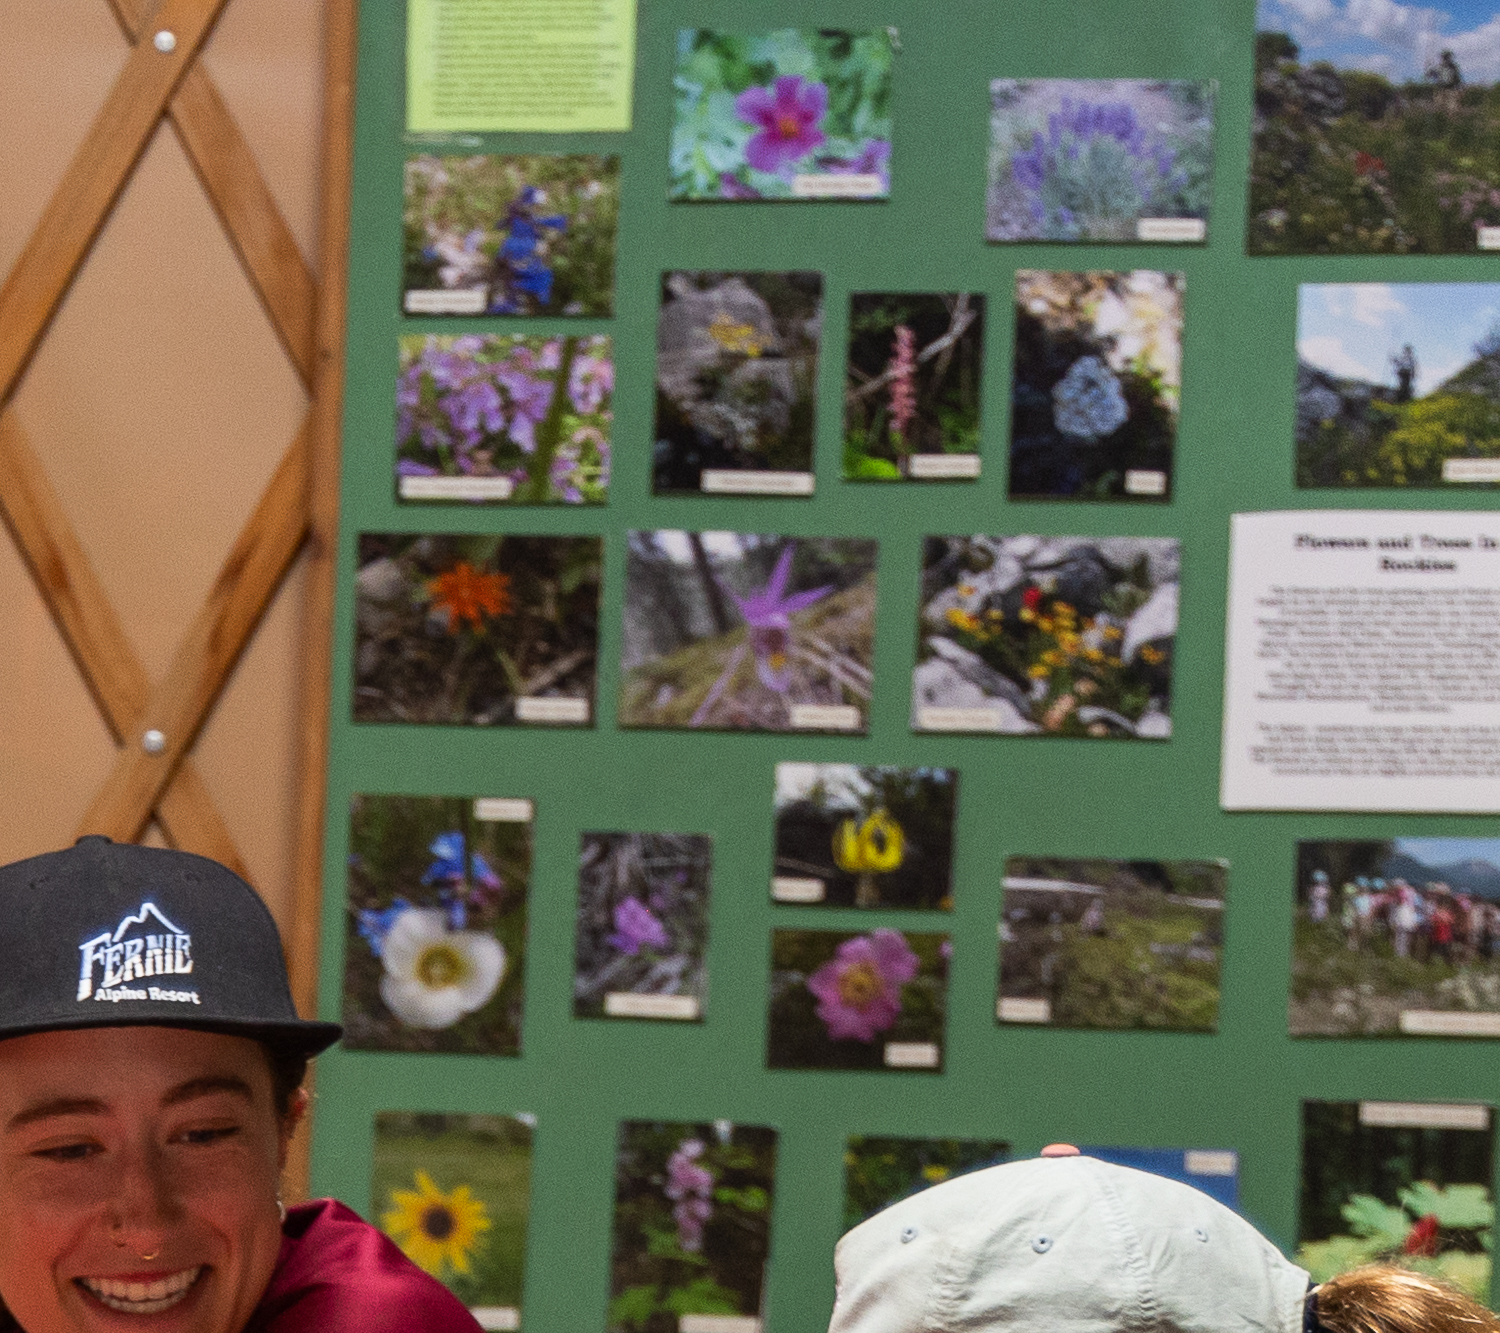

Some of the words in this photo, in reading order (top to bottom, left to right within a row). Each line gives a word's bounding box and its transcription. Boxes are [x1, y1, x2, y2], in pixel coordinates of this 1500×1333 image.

[1295, 533, 1370, 552] Flowers
[1377, 533, 1412, 552] and
[77, 932, 194, 1002] FERNIE
[94, 985, 148, 1003] Alpine
[147, 986, 202, 1005] Resort
